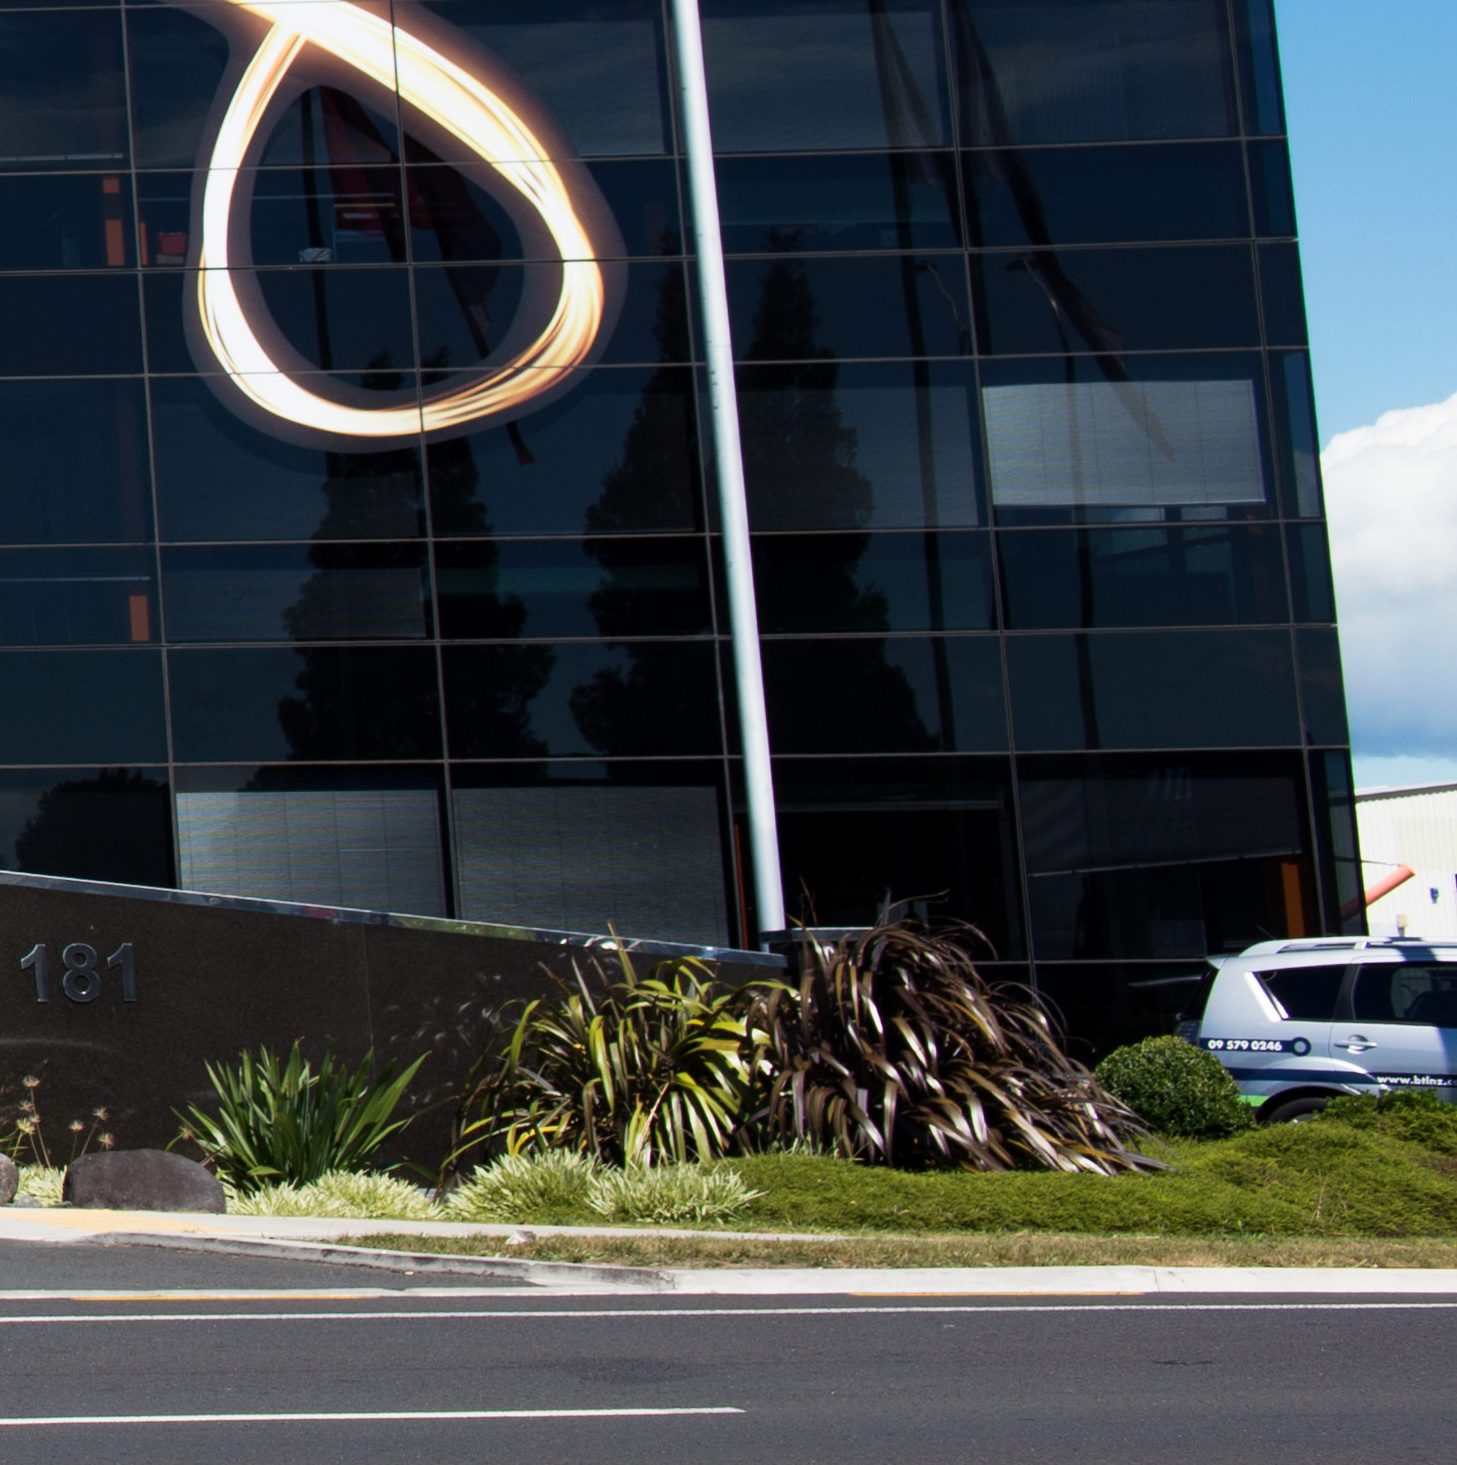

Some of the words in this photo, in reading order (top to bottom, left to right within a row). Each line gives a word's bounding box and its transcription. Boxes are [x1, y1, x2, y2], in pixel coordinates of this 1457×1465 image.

[19, 942, 138, 1003] 181
[1207, 1039, 1224, 1050] 09
[1226, 1039, 1250, 1051] 579
[1250, 1040, 1283, 1052] 0246
